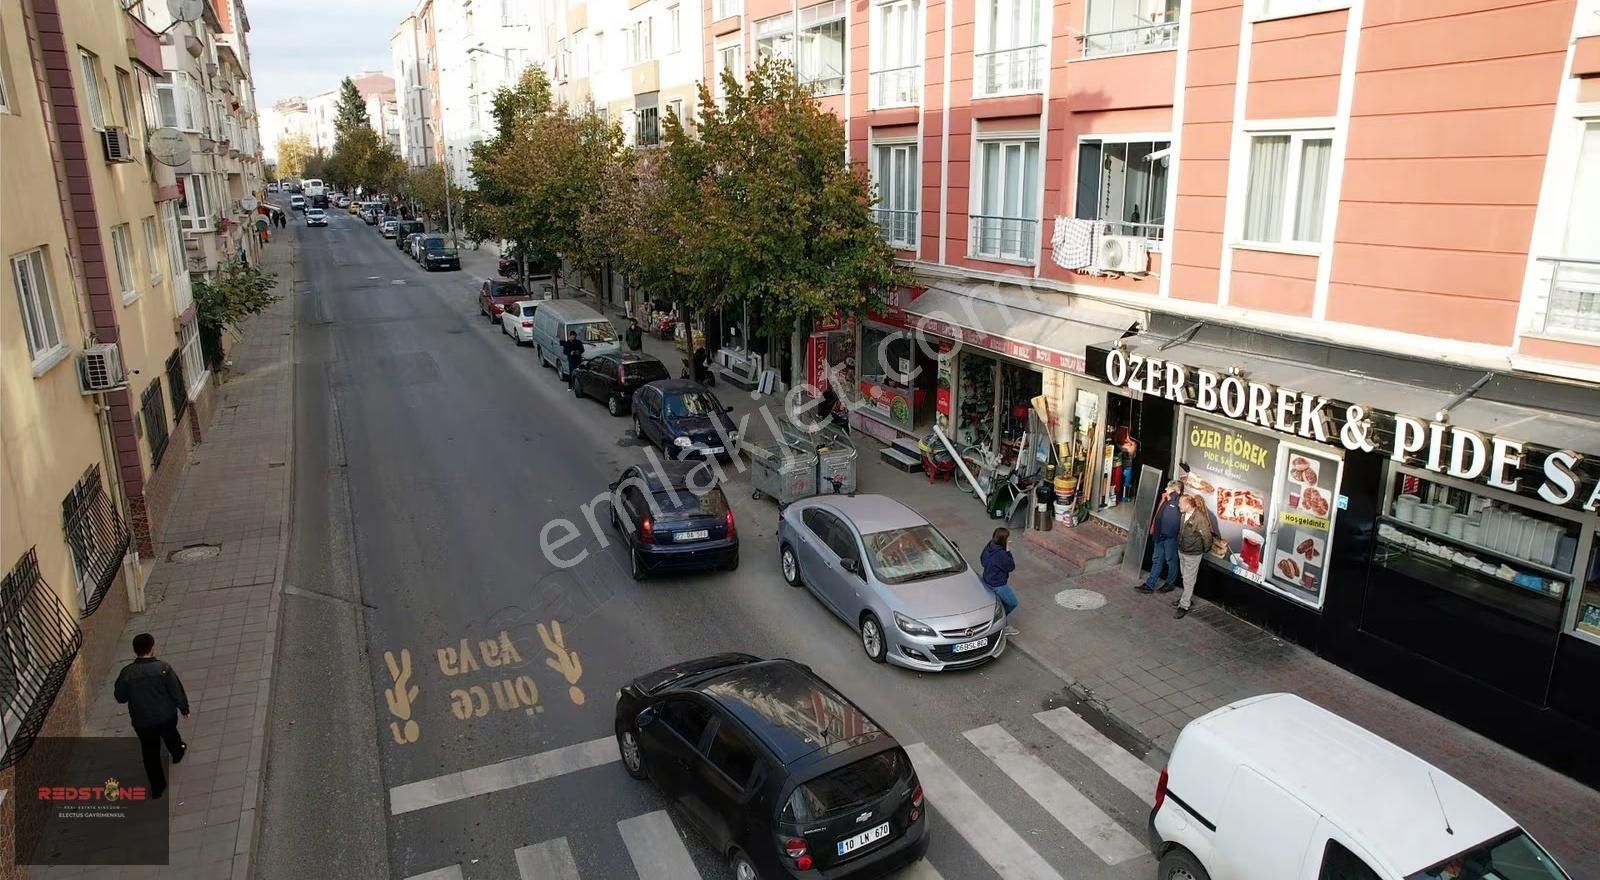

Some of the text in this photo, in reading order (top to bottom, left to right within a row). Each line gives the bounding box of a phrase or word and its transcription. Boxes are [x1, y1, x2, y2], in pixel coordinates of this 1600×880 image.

[1105, 340, 1186, 404] ÖZER
[1197, 366, 1328, 442] BÖREK
[1340, 404, 1375, 452] &
[1393, 410, 1523, 492] PİDE
[1190, 425, 1268, 469] ÖZER BÖREK
[450, 675, 545, 721] önce
[844, 824, 889, 850] 10 LN 670
